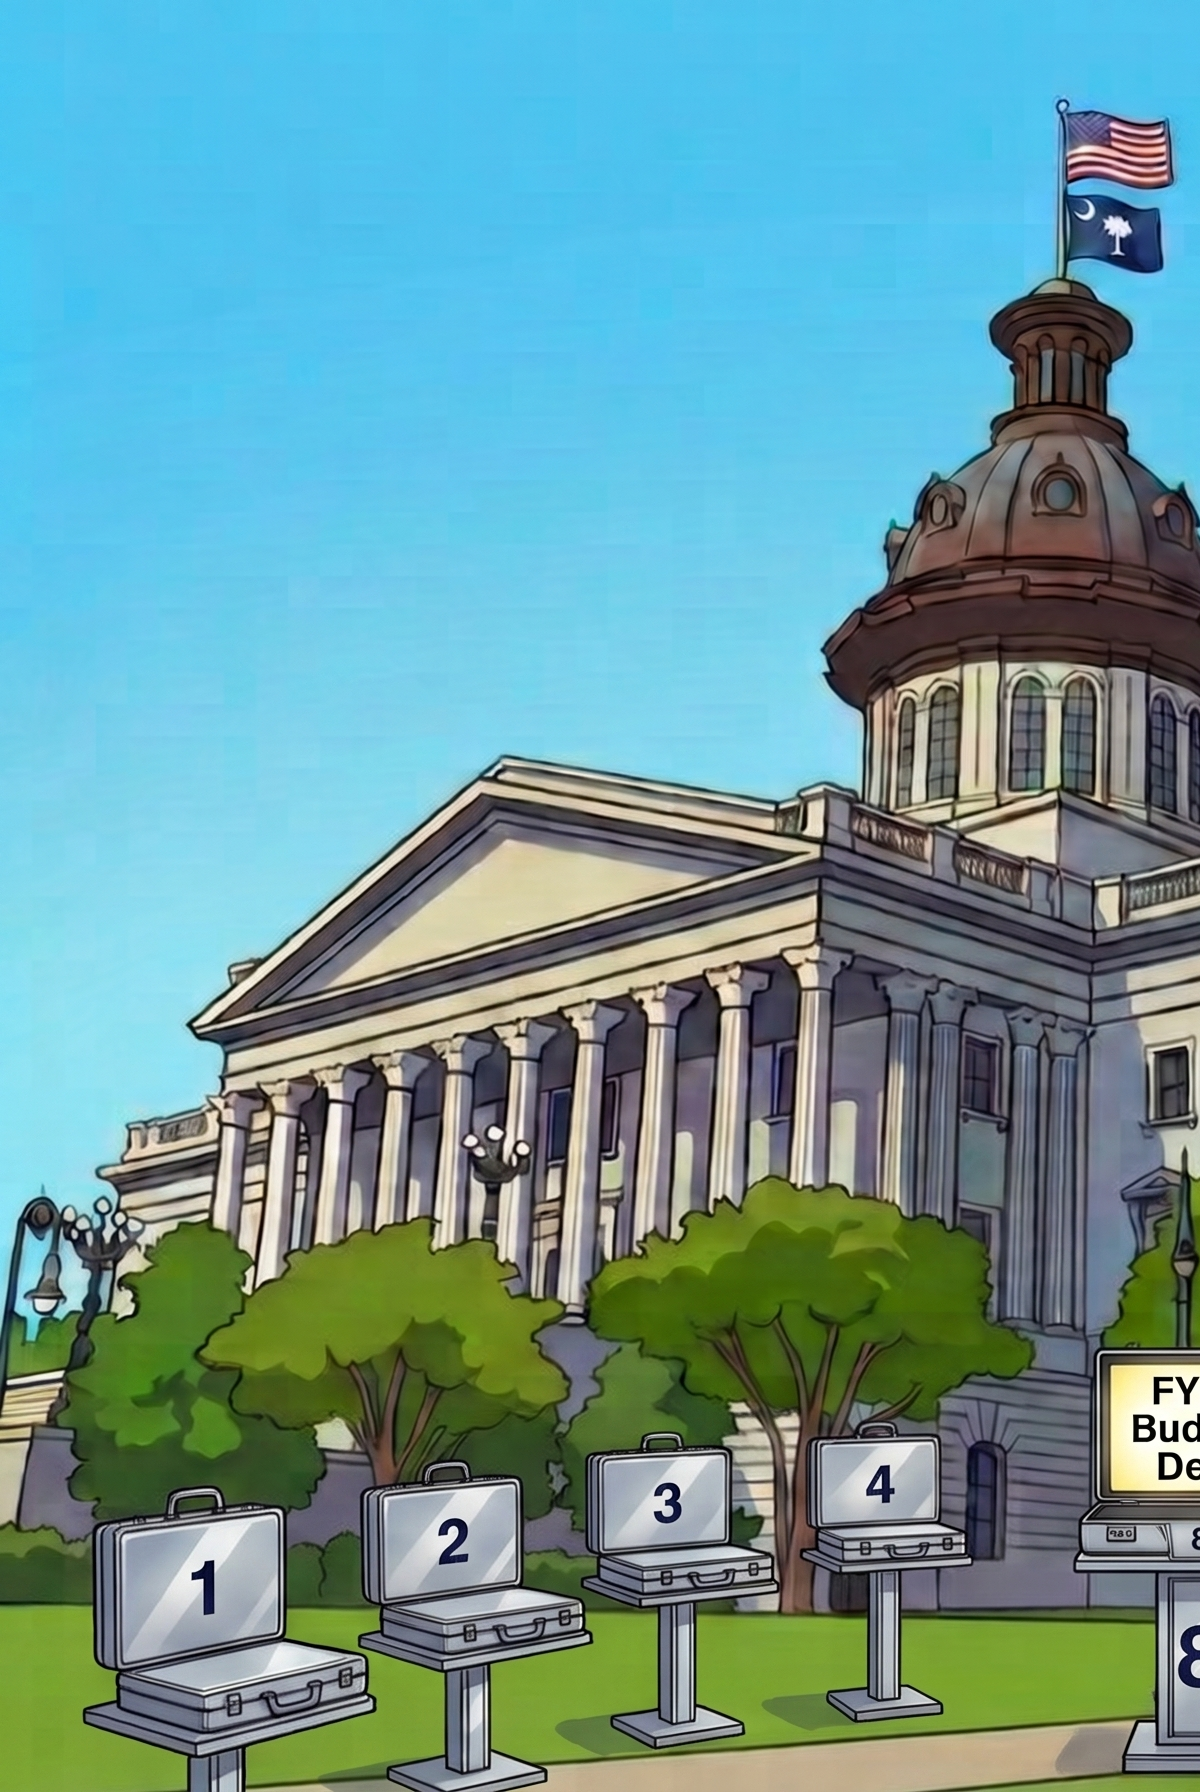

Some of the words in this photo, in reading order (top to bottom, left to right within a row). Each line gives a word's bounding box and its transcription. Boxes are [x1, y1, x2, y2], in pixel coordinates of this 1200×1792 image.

[653, 1482, 683, 1524] 3
[865, 1464, 896, 1504] 4
[437, 1517, 469, 1566] 2
[191, 1559, 216, 1616] 1
